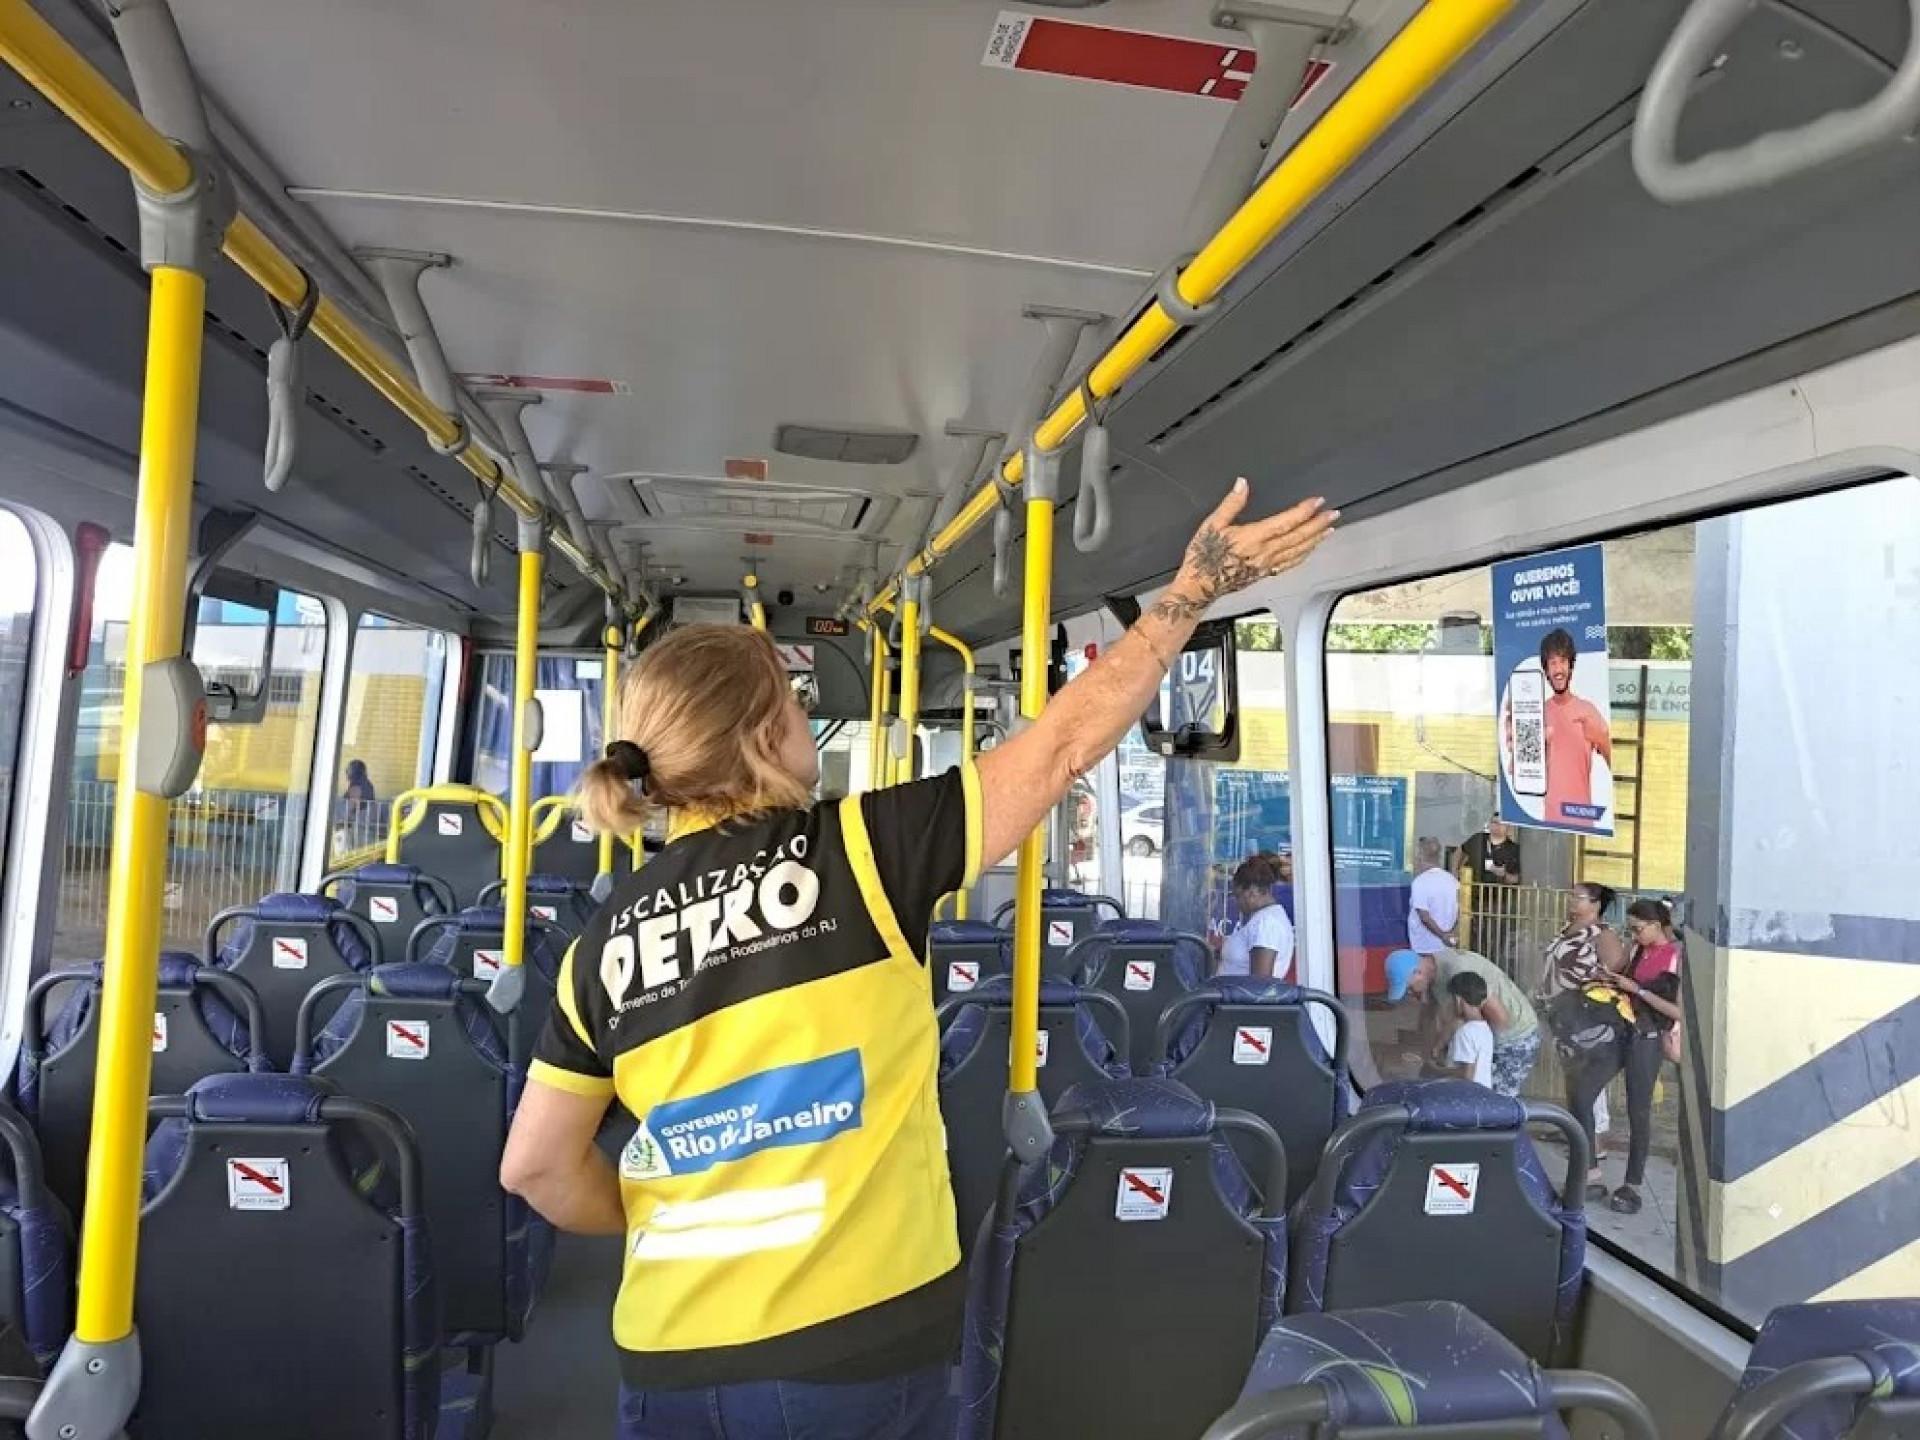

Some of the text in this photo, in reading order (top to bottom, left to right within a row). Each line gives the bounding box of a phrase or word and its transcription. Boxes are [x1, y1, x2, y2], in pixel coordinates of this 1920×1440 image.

[1513, 562, 1575, 587] QUEREMOS
[1510, 585, 1544, 604] OUVIR
[1182, 649, 1215, 683] 04
[819, 917, 838, 933] RJ
[660, 1107, 739, 1138] GOVERNO
[667, 1132, 716, 1161] Rio
[737, 1101, 854, 1145] Janeiro
